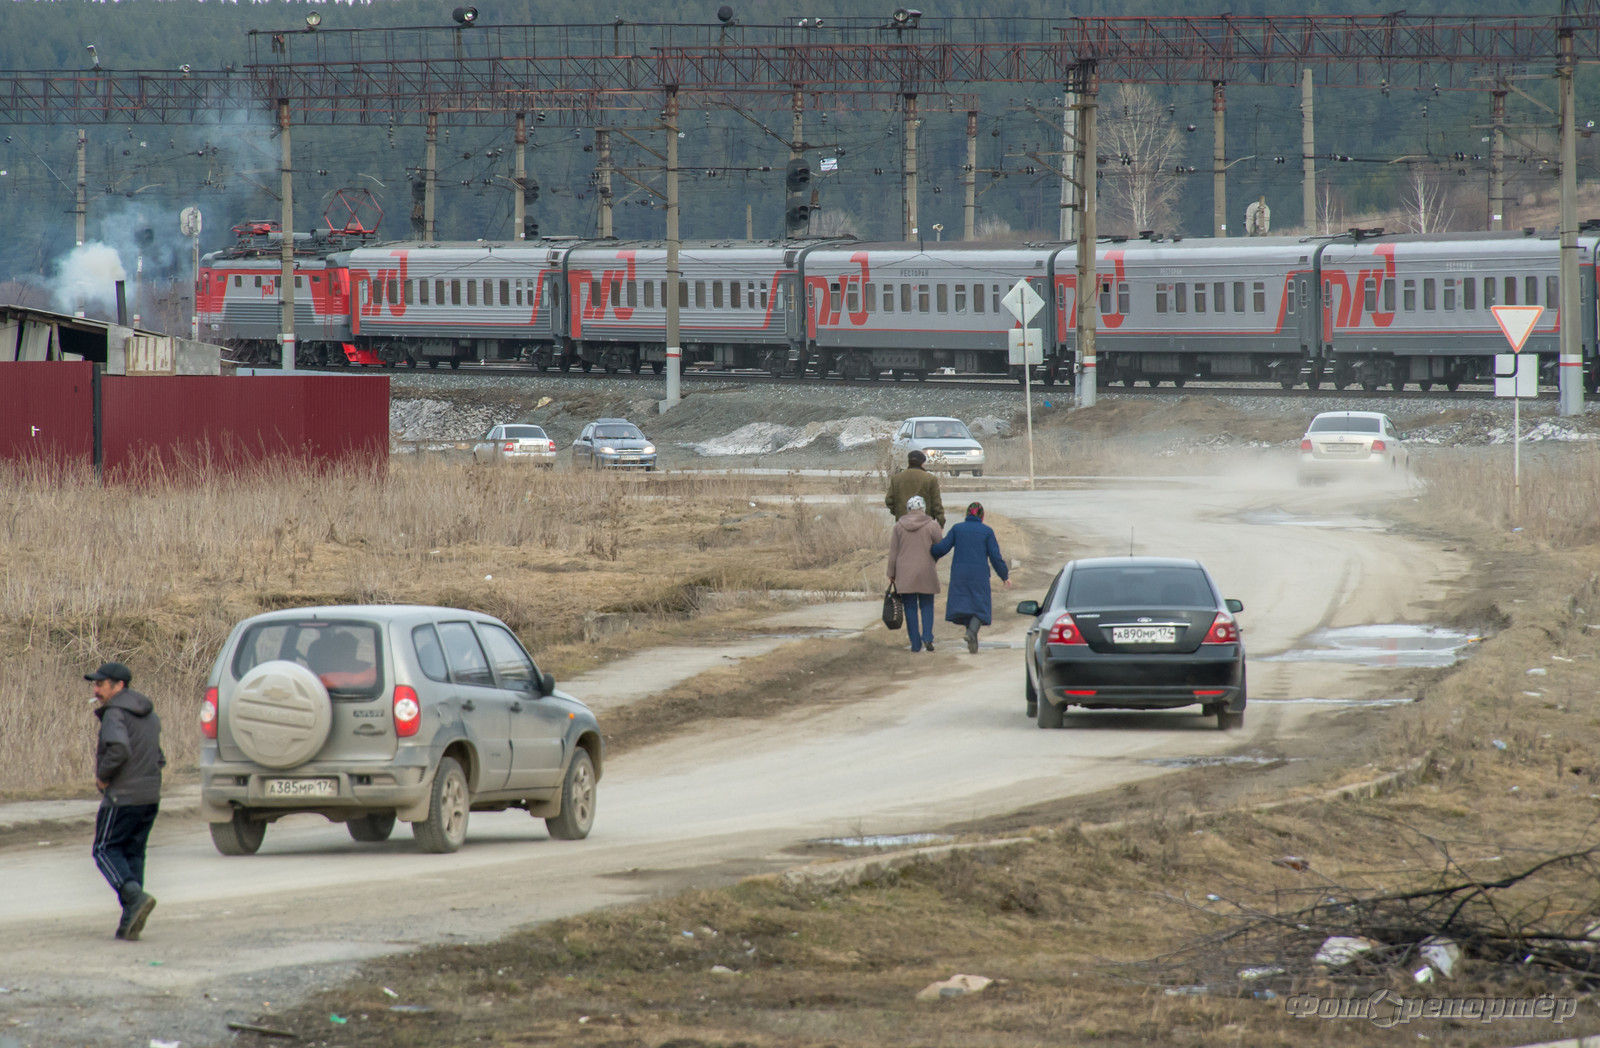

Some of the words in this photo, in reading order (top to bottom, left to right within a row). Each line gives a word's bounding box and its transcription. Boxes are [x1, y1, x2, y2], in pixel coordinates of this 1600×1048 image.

[1117, 629, 1156, 639] А890МР
[1157, 628, 1172, 636] 174
[269, 781, 315, 794] А385МР
